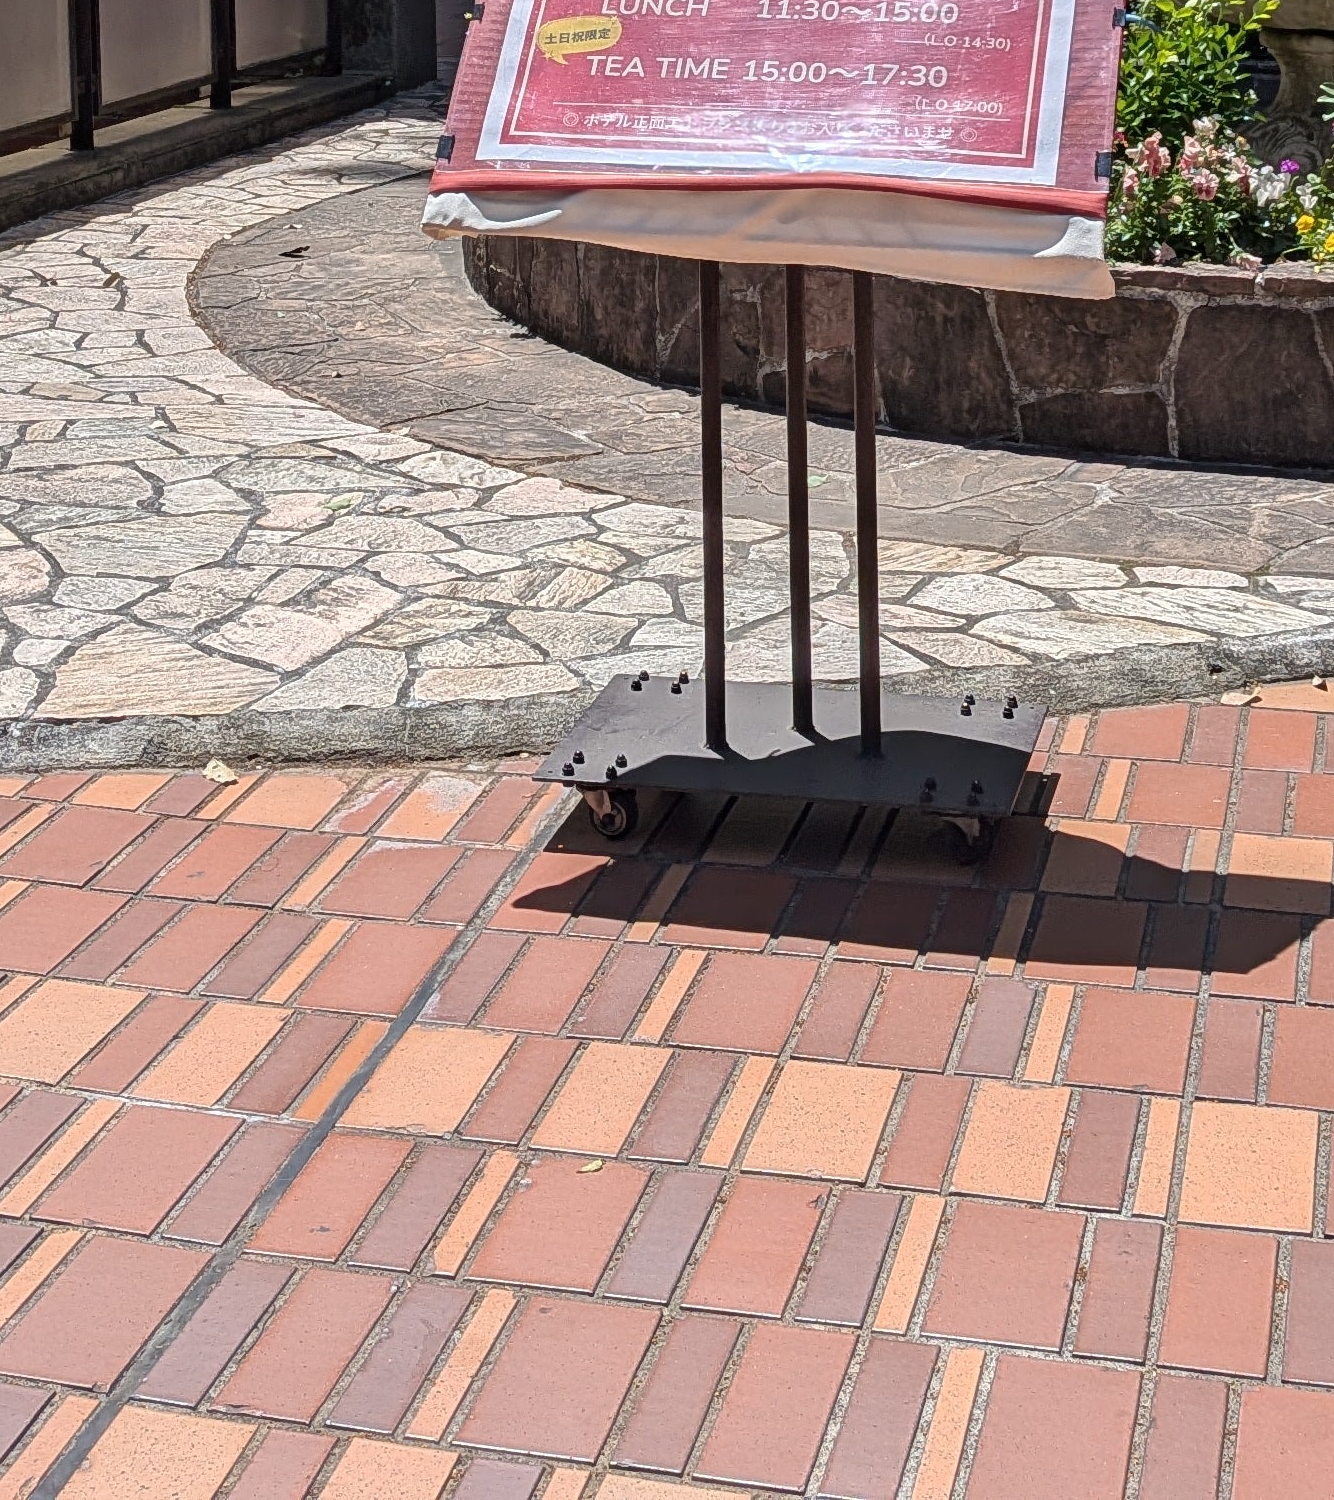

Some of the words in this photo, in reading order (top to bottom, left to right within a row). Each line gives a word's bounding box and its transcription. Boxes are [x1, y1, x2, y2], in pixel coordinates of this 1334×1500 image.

[543, 27, 612, 46] 土日祝限定
[586, 55, 645, 78] TEA
[655, 57, 732, 80] TIME
